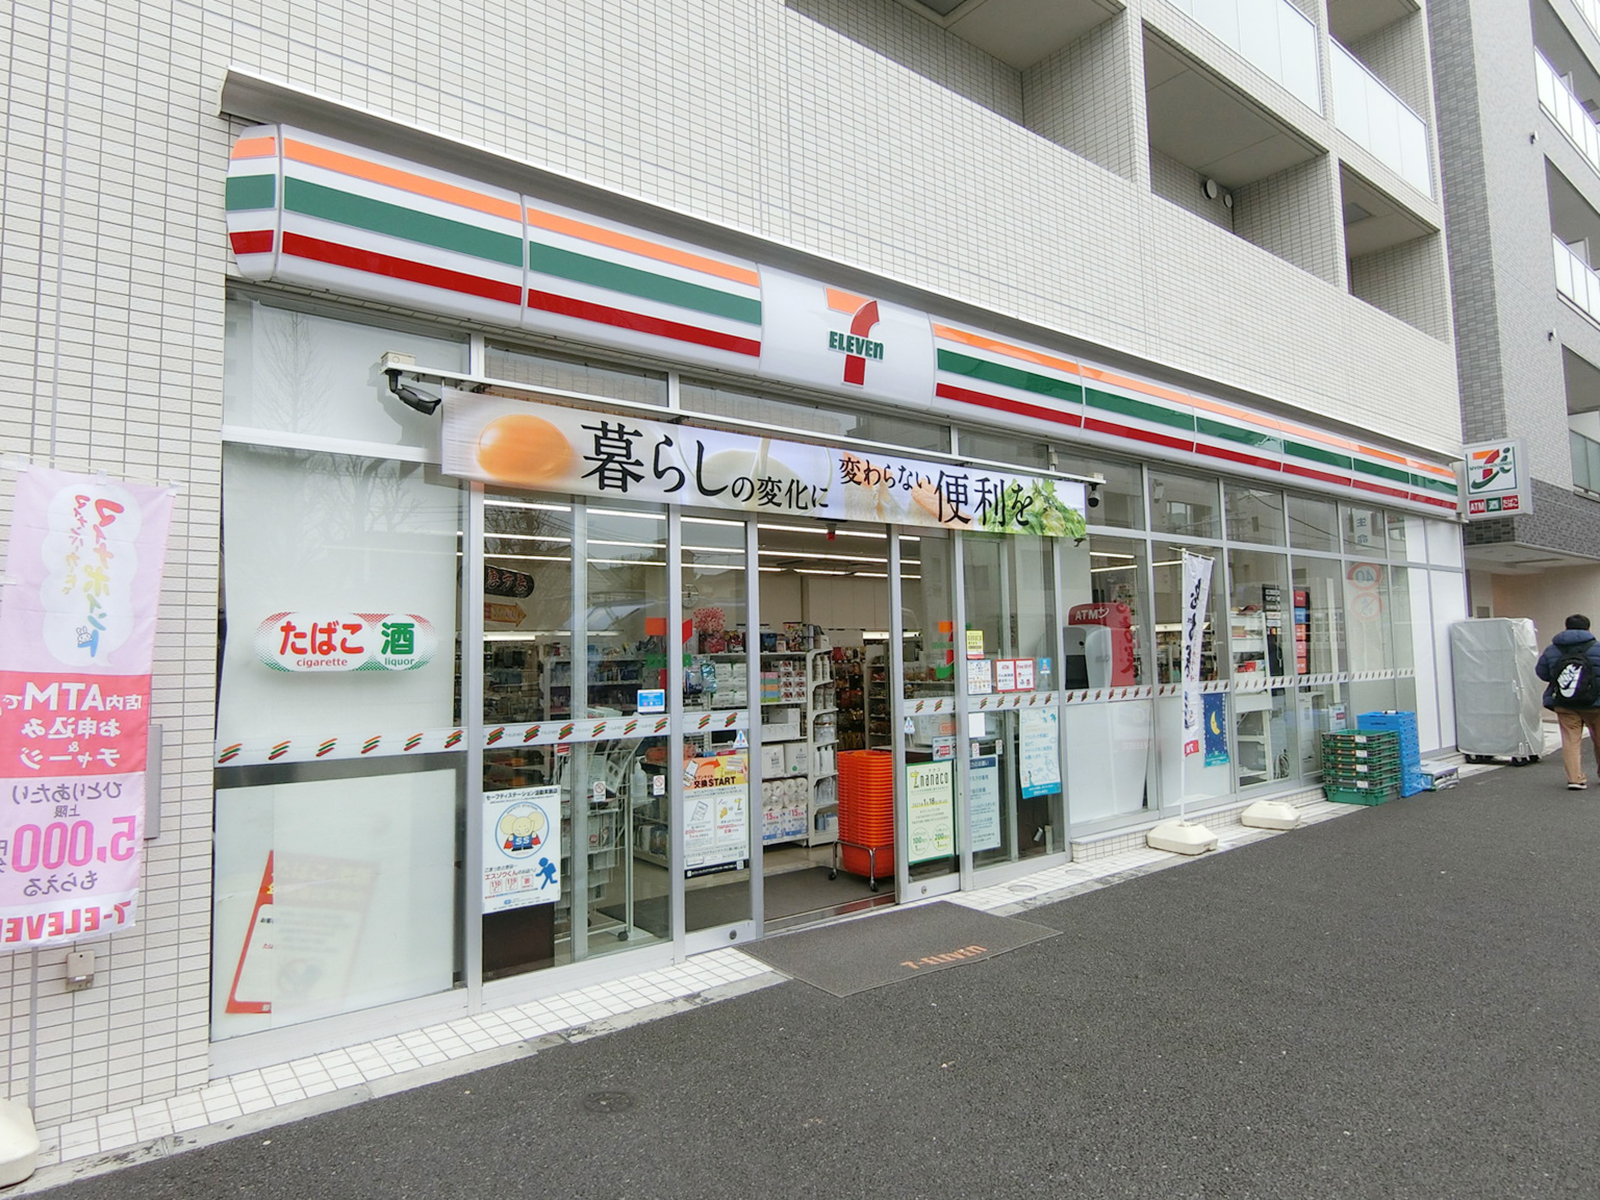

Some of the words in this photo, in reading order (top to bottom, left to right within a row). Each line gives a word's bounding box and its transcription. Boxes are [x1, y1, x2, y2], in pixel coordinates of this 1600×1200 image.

[581, 420, 829, 510] 暮らしの変化に
[838, 457, 1034, 527] 変わらない便利を
[1469, 501, 1485, 513] ATM
[1075, 609, 1099, 621] ATM
[280, 620, 365, 656] たばこ
[381, 622, 415, 656] 酒
[296, 657, 348, 668] cigarette
[384, 657, 416, 667] liquor
[920, 772, 949, 787] nanaco
